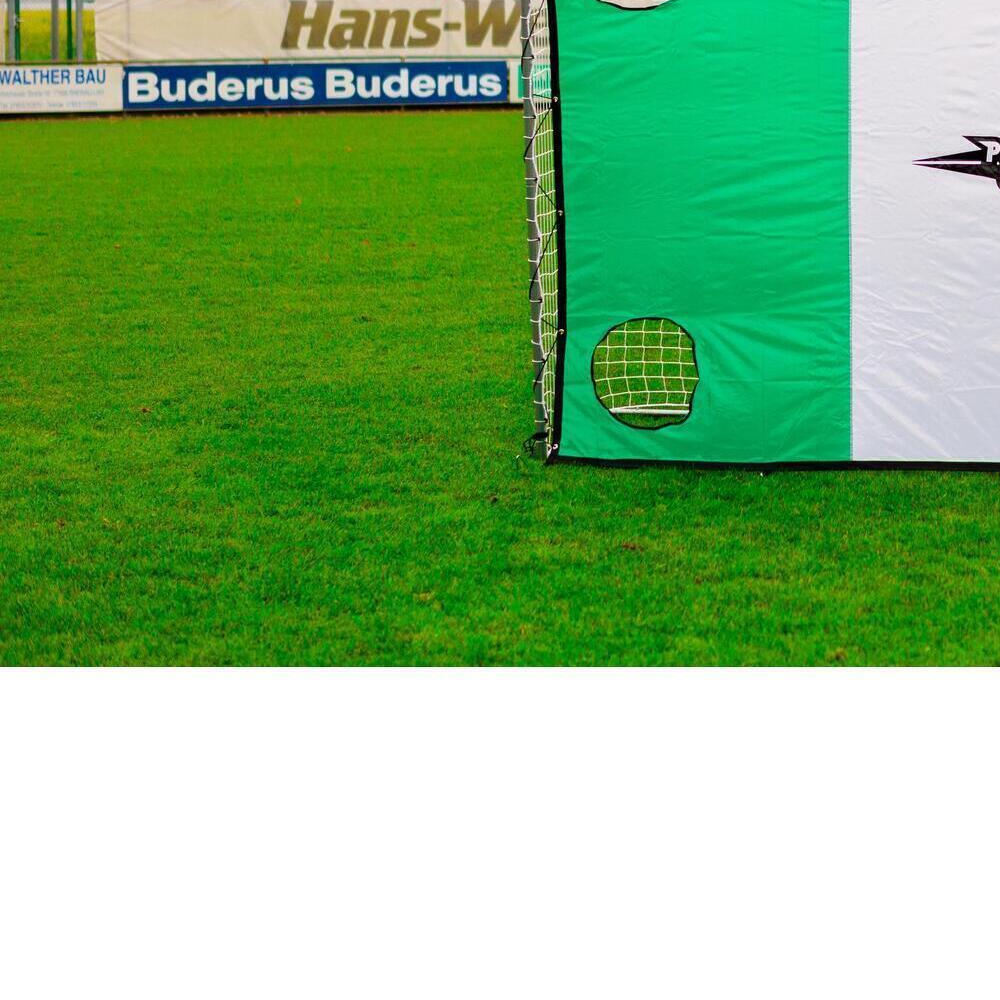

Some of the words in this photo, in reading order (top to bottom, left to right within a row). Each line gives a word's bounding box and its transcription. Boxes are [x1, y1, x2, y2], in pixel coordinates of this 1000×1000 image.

[0, 69, 71, 85] WALTHER
[75, 69, 107, 84] BAU
[128, 71, 315, 104] Buderus
[325, 68, 502, 99] Buderus
